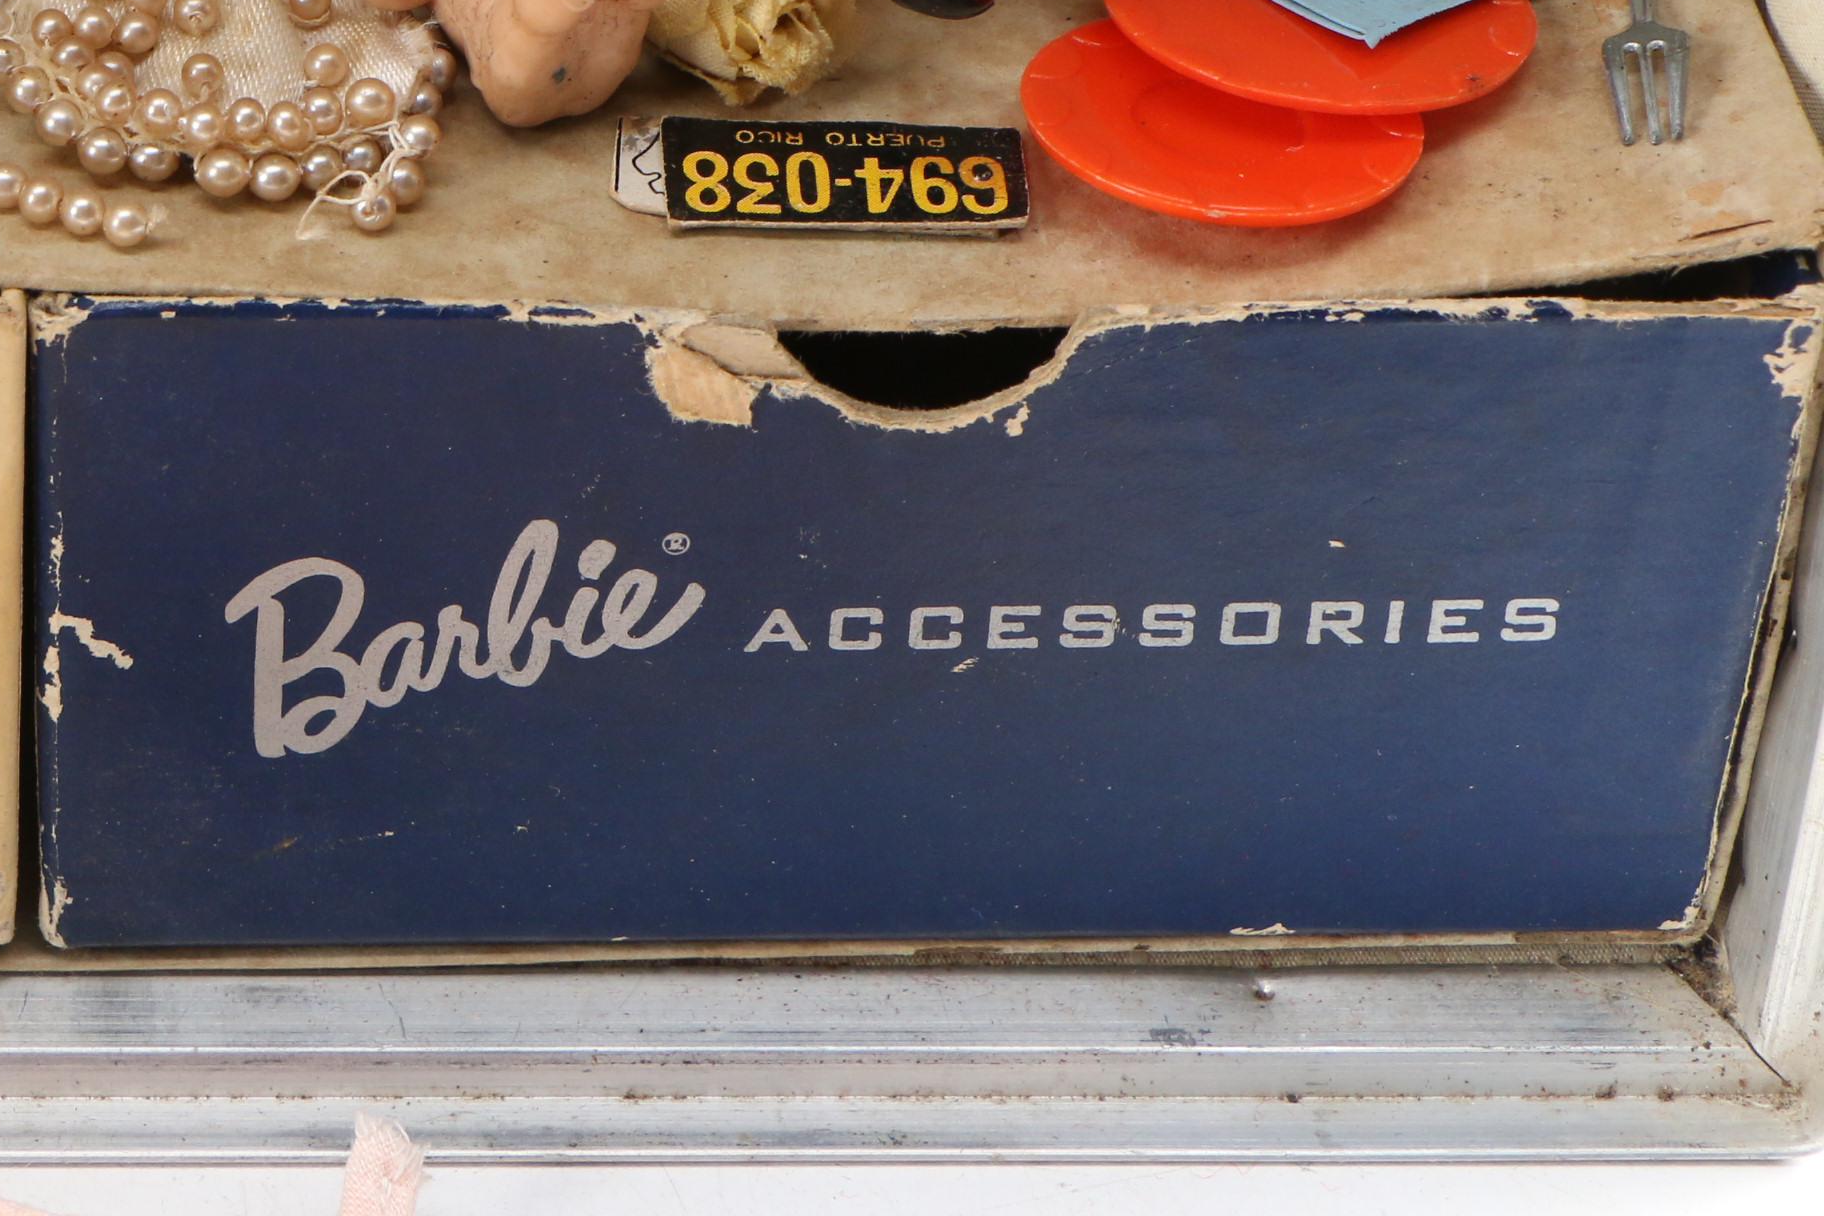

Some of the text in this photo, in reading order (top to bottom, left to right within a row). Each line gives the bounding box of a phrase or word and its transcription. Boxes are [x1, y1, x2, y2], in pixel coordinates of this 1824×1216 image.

[735, 130, 945, 148] PUERTO RICO
[681, 150, 1009, 216] 694-038
[743, 597, 1561, 653] ACCESSORIES
